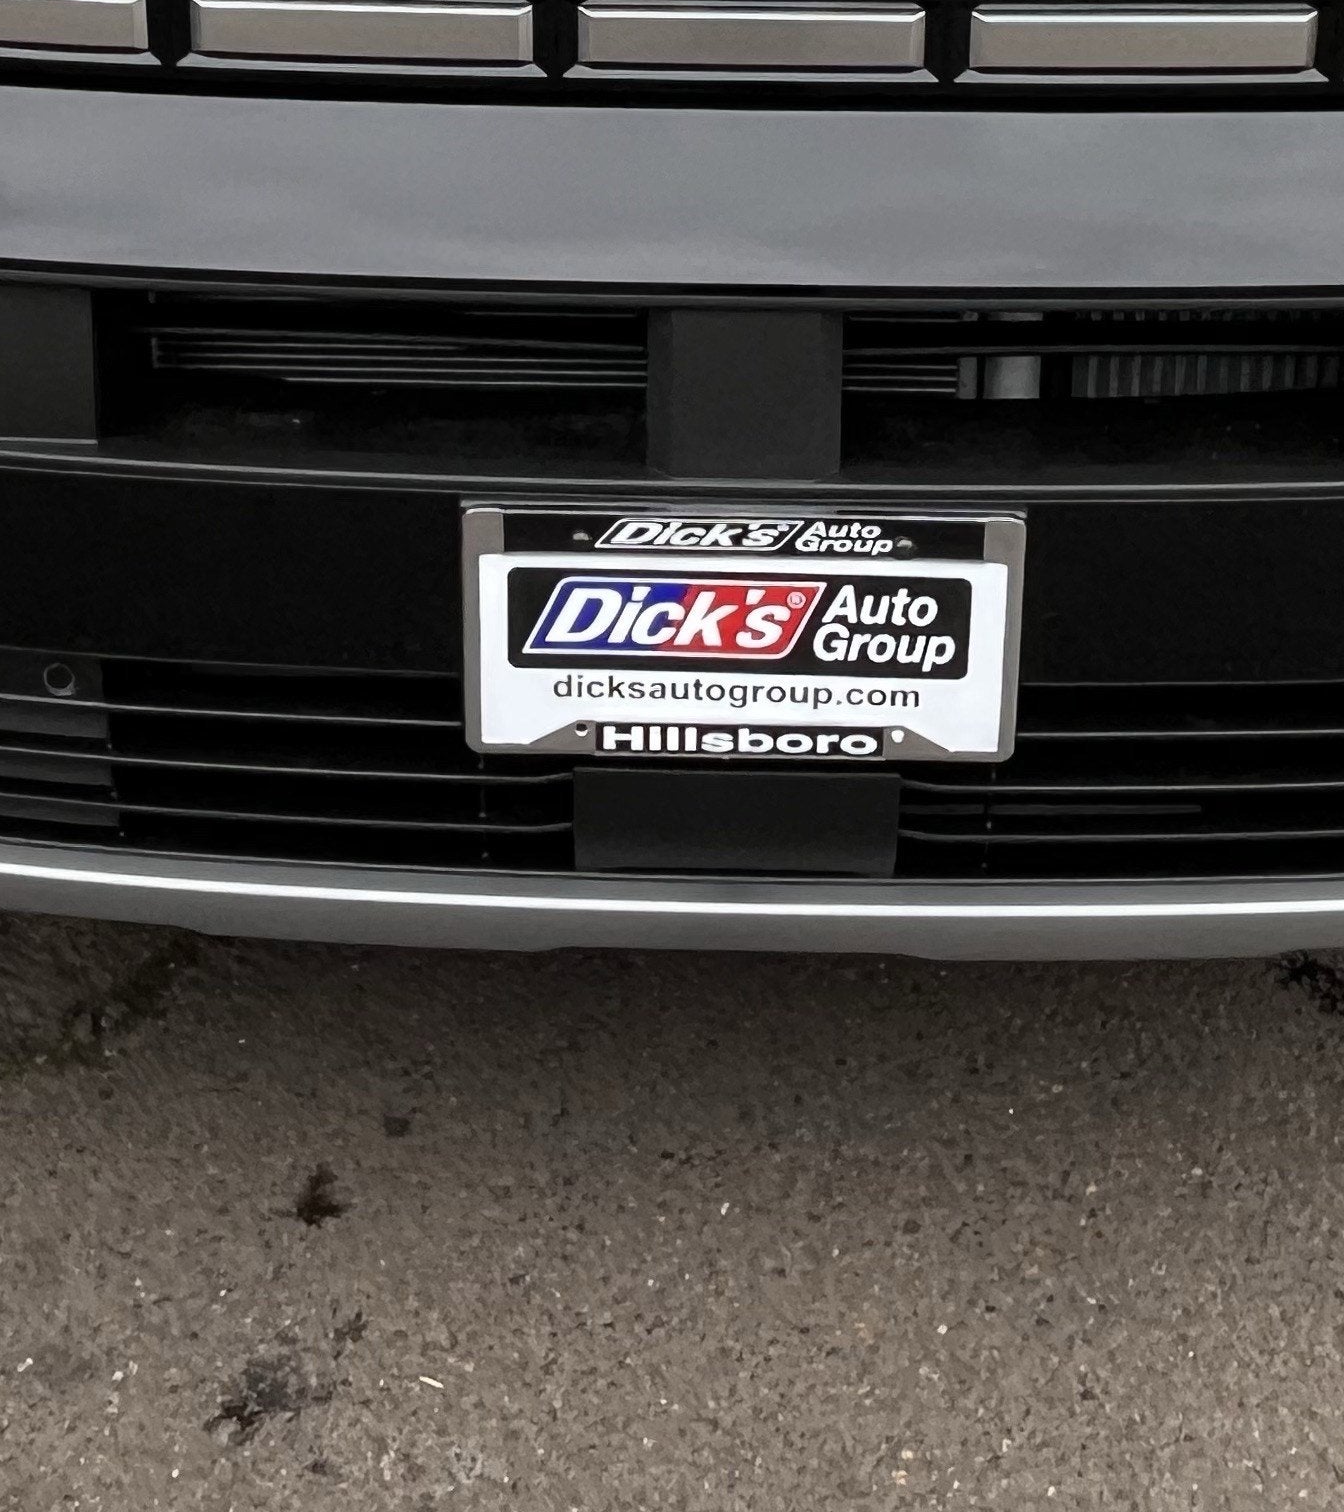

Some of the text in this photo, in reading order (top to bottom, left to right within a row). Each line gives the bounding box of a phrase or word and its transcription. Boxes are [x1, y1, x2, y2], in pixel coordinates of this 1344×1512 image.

[612, 520, 786, 548] Dick's
[810, 521, 882, 538] Auto
[794, 536, 894, 556] Group
[545, 586, 791, 648] Dick's
[822, 585, 939, 626] Auto
[812, 625, 957, 672] Group
[553, 675, 921, 708] dicksautogroup.com
[602, 727, 878, 755] Hillsboro
